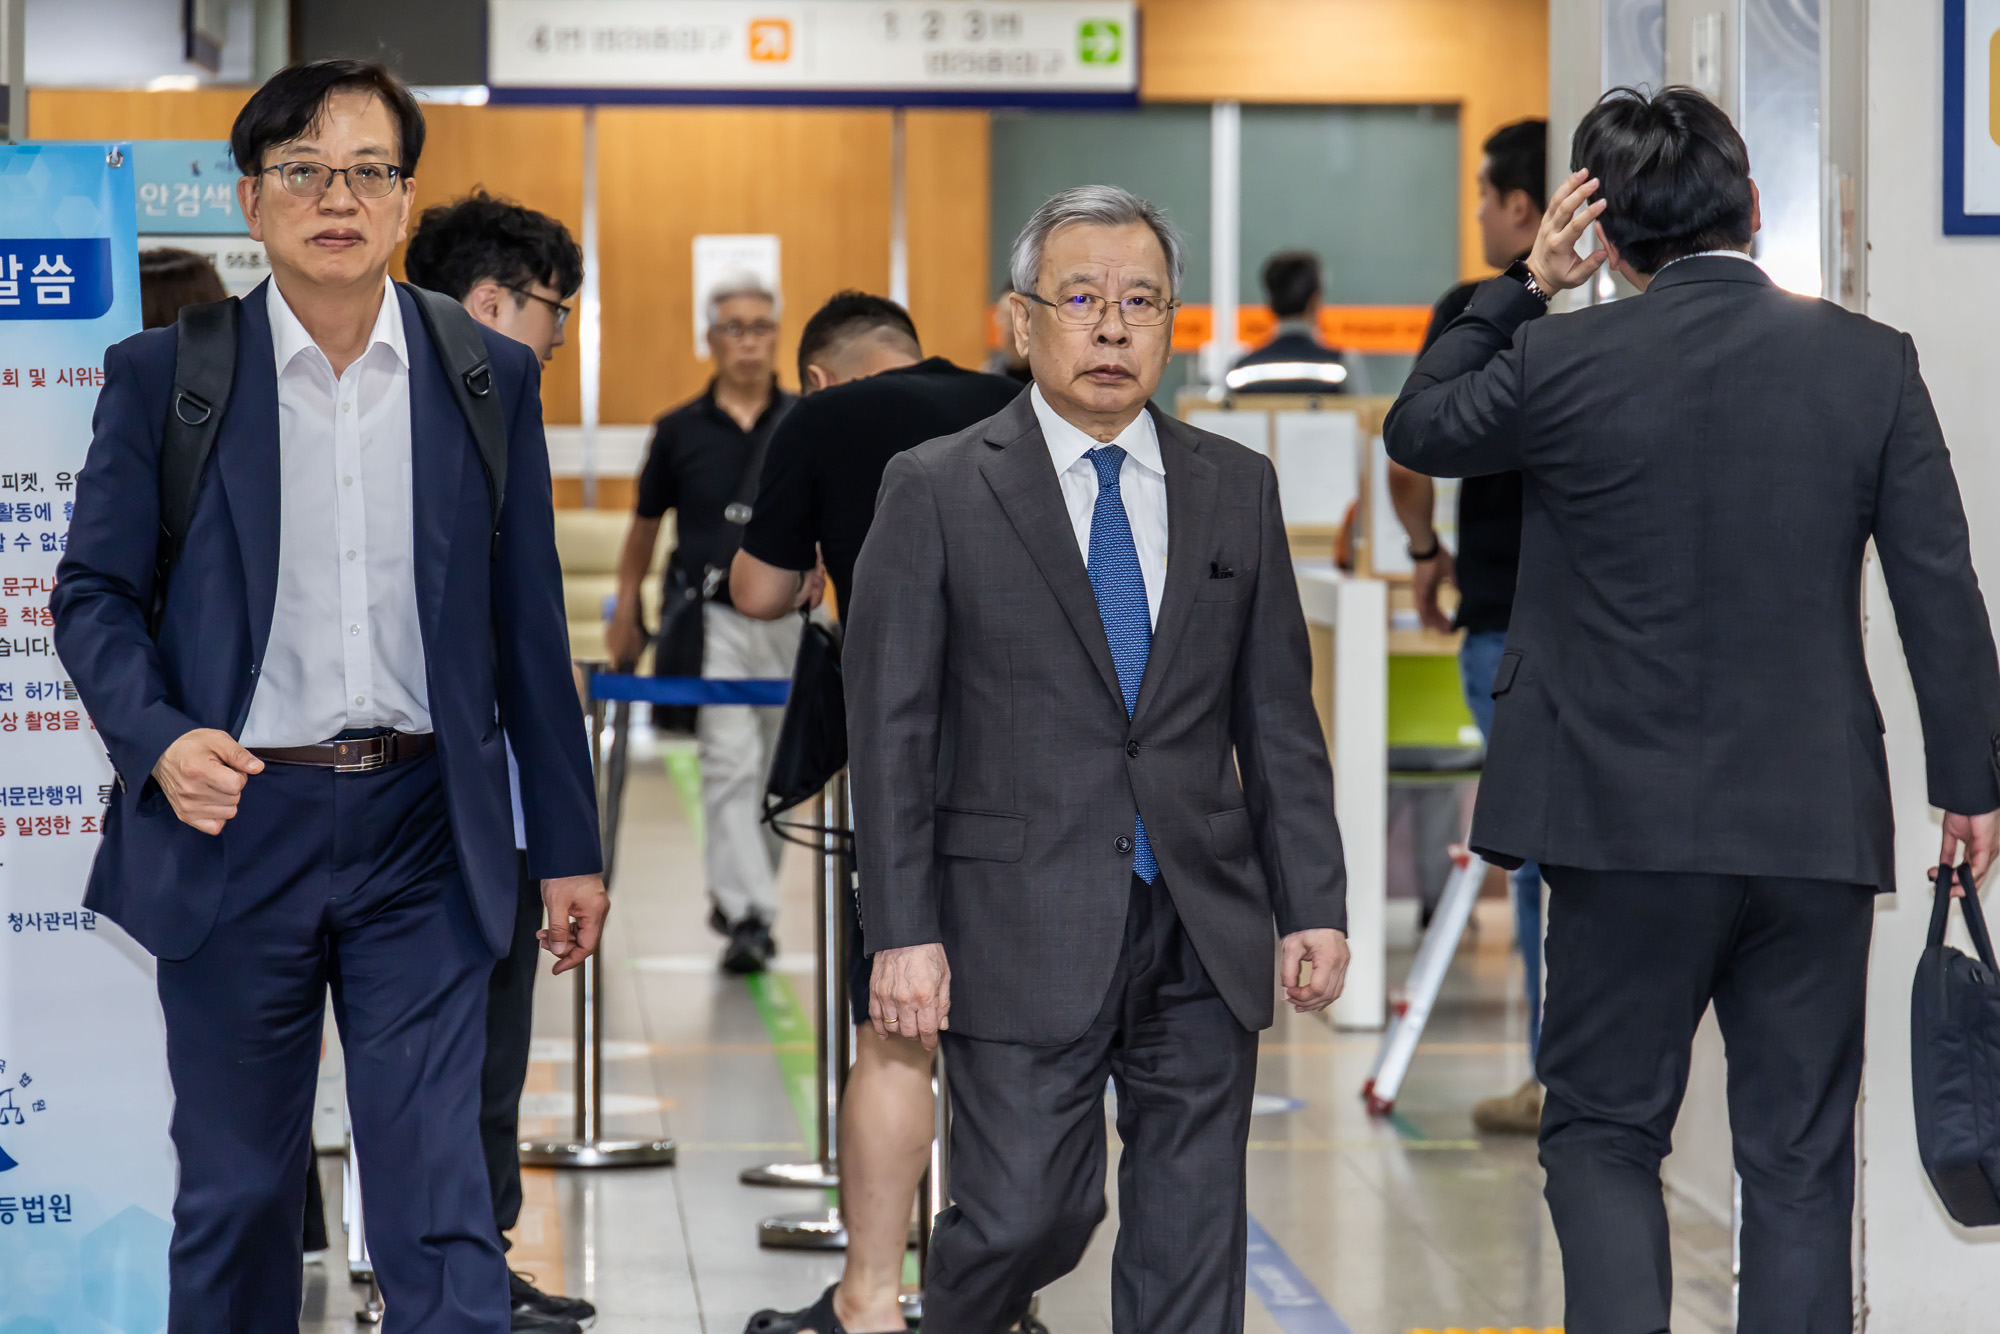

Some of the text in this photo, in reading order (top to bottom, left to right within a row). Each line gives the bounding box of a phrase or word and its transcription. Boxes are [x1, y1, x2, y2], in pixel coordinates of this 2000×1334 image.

[135, 182, 233, 217] 안검색
[2, 368, 19, 388] 회
[28, 367, 46, 388] 및
[2, 471, 80, 493] 피켓, 유
[13, 531, 32, 553] 수
[25, 710, 81, 731] 촬영을
[16, 815, 72, 836] 일정한
[80, 814, 105, 834] 조
[7, 911, 98, 933] 청사관리관
